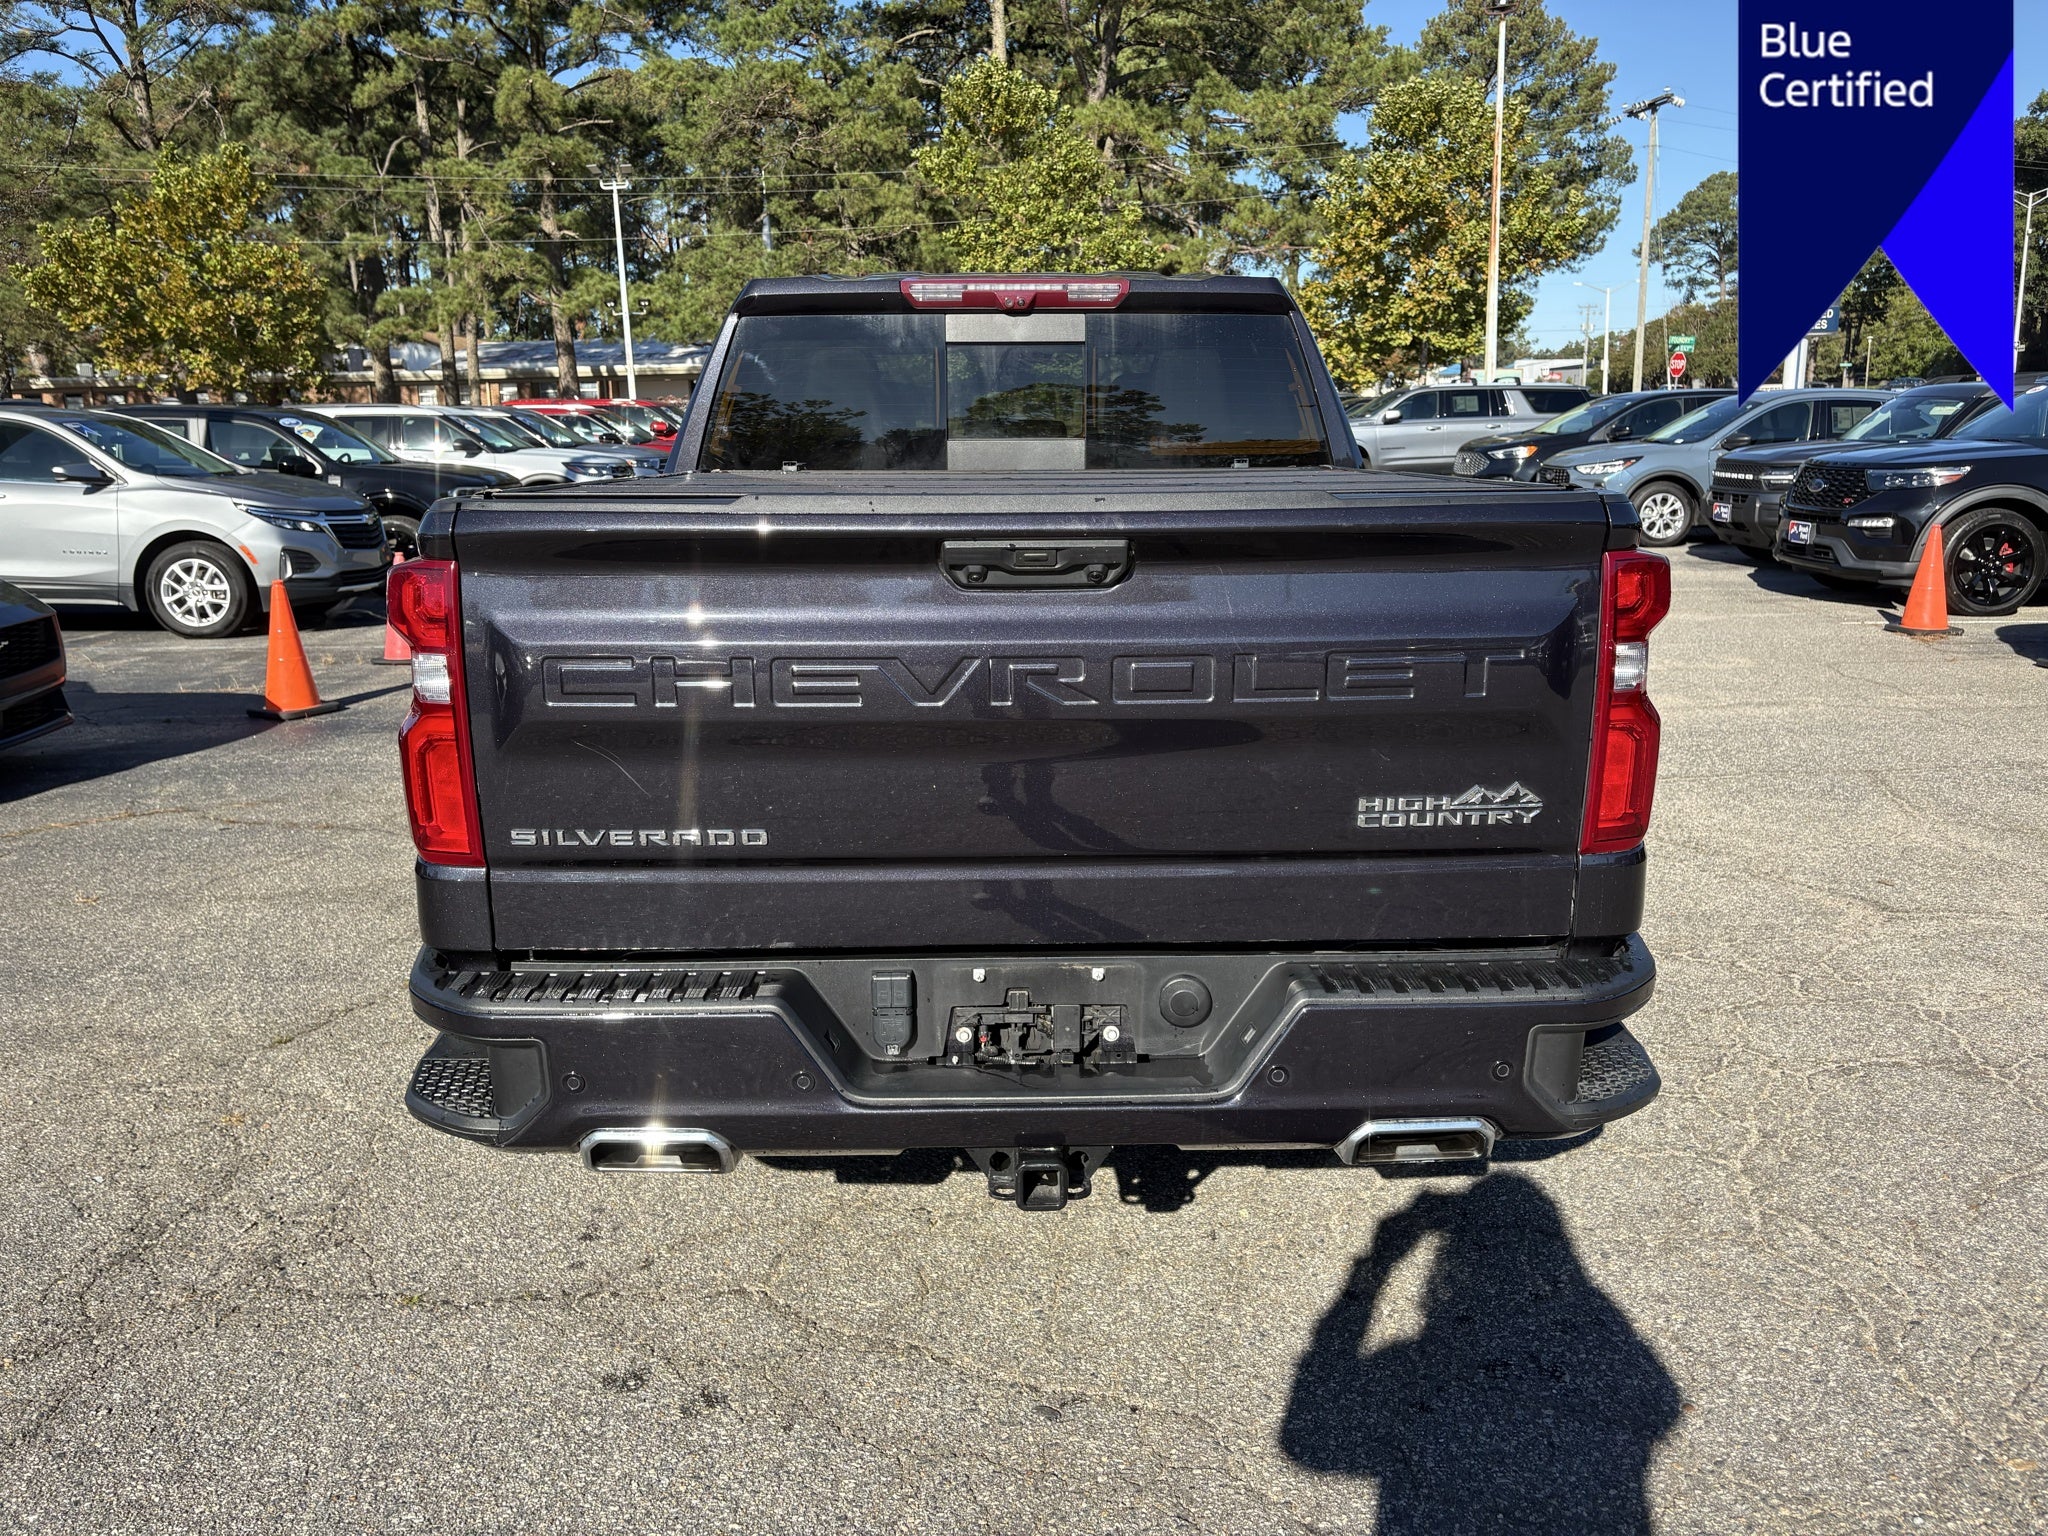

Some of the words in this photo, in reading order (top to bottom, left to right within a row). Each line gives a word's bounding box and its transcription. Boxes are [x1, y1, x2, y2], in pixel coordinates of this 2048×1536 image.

[1671, 359, 1686, 370] STOP
[541, 648, 1526, 708] CHEVROLET
[1358, 797, 1451, 811] HIGH
[1357, 808, 1542, 828] COUNTRY
[510, 828, 769, 847] SILVERADO
